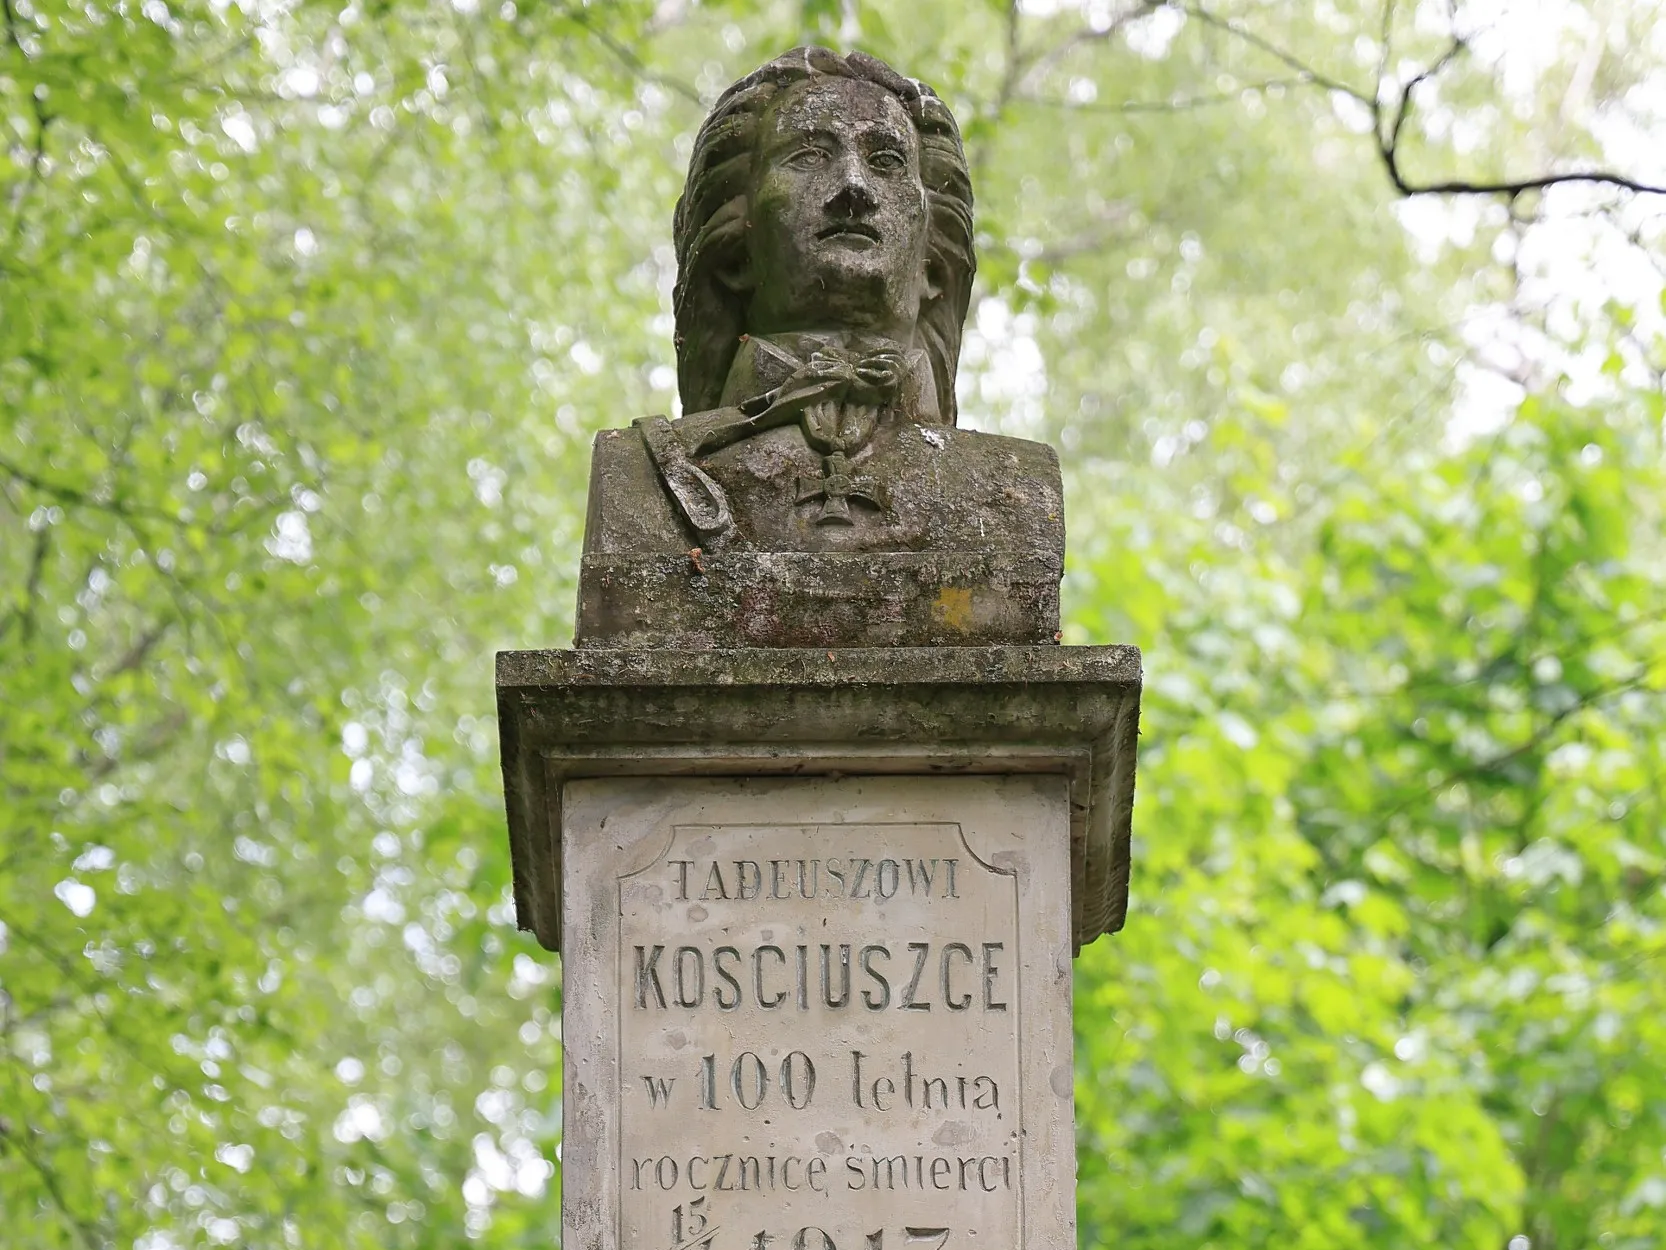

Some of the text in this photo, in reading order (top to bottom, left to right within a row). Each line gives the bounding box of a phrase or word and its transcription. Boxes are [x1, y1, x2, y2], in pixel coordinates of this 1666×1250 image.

[666, 858, 961, 901] TADEUSZOWI
[640, 1074, 676, 1111] w
[697, 1050, 817, 1112] 100
